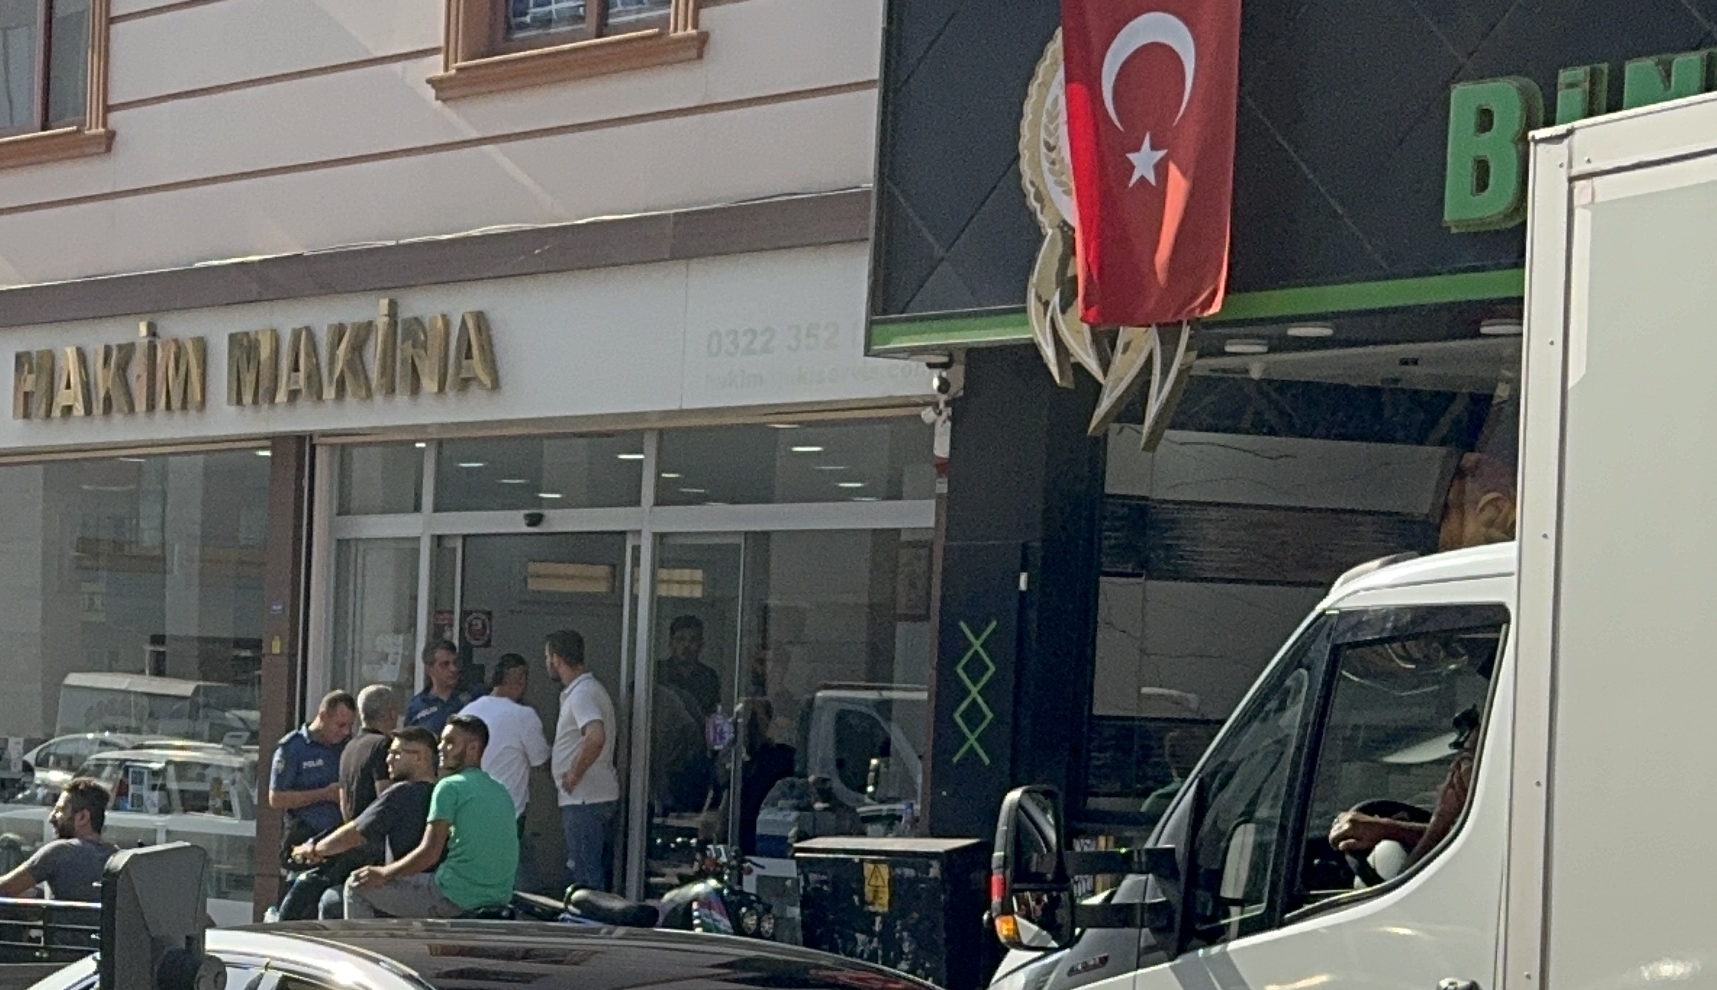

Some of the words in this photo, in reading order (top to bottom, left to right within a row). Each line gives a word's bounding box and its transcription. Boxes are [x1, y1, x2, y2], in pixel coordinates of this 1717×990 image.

[13, 320, 206, 419] HAKİM
[227, 298, 500, 406] MAKİNA
[706, 327, 776, 358] 0322
[786, 322, 840, 351] 352
